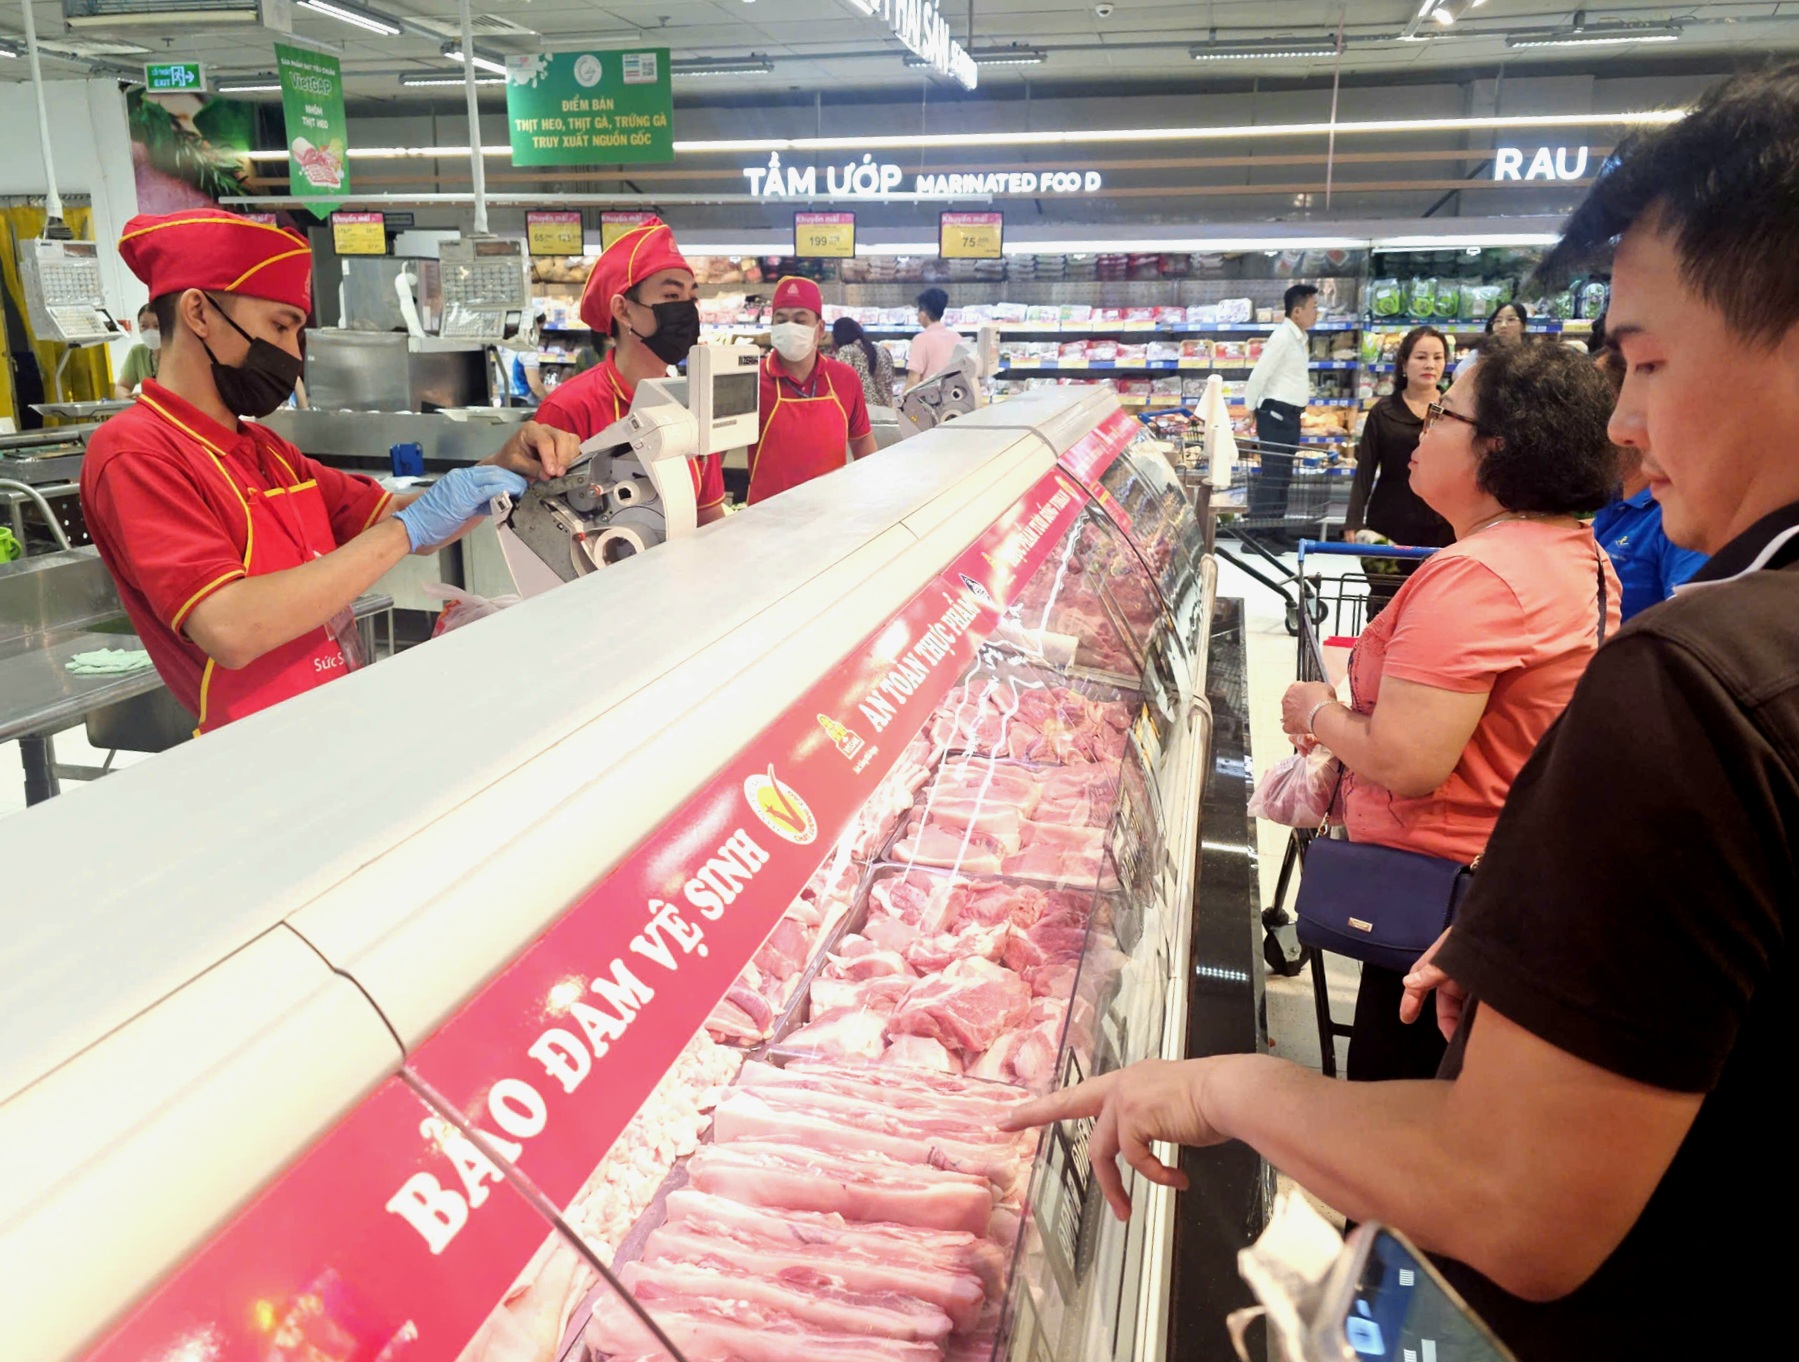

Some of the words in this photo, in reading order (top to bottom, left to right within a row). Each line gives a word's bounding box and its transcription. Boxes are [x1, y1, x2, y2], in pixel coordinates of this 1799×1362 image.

[289, 71, 332, 95] VietGAP
[562, 94, 589, 111] ĐIỂM
[592, 97, 614, 111] BÁN
[515, 118, 538, 133] THỊT
[541, 118, 566, 131] HEO,
[568, 117, 591, 132] THỊT
[614, 112, 650, 127] TRỨNG
[653, 111, 667, 126] GÀ
[532, 136, 559, 148] TRUY
[562, 131, 589, 147] XUẤT
[630, 129, 652, 145] GỐC
[743, 151, 816, 197] TẨM
[827, 153, 903, 197] ƯỚP
[1494, 146, 1588, 180] RAU
[916, 172, 1037, 194] MARINATED
[809, 236, 828, 247] 199
[962, 237, 976, 248] 75
[314, 656, 337, 672] Sức
[858, 689, 897, 732] AN
[914, 623, 957, 667] THỰC
[941, 592, 981, 637] PHẨM
[385, 1078, 547, 1256] BẢO
[629, 899, 709, 971] VỆ
[684, 828, 770, 921] SINH
